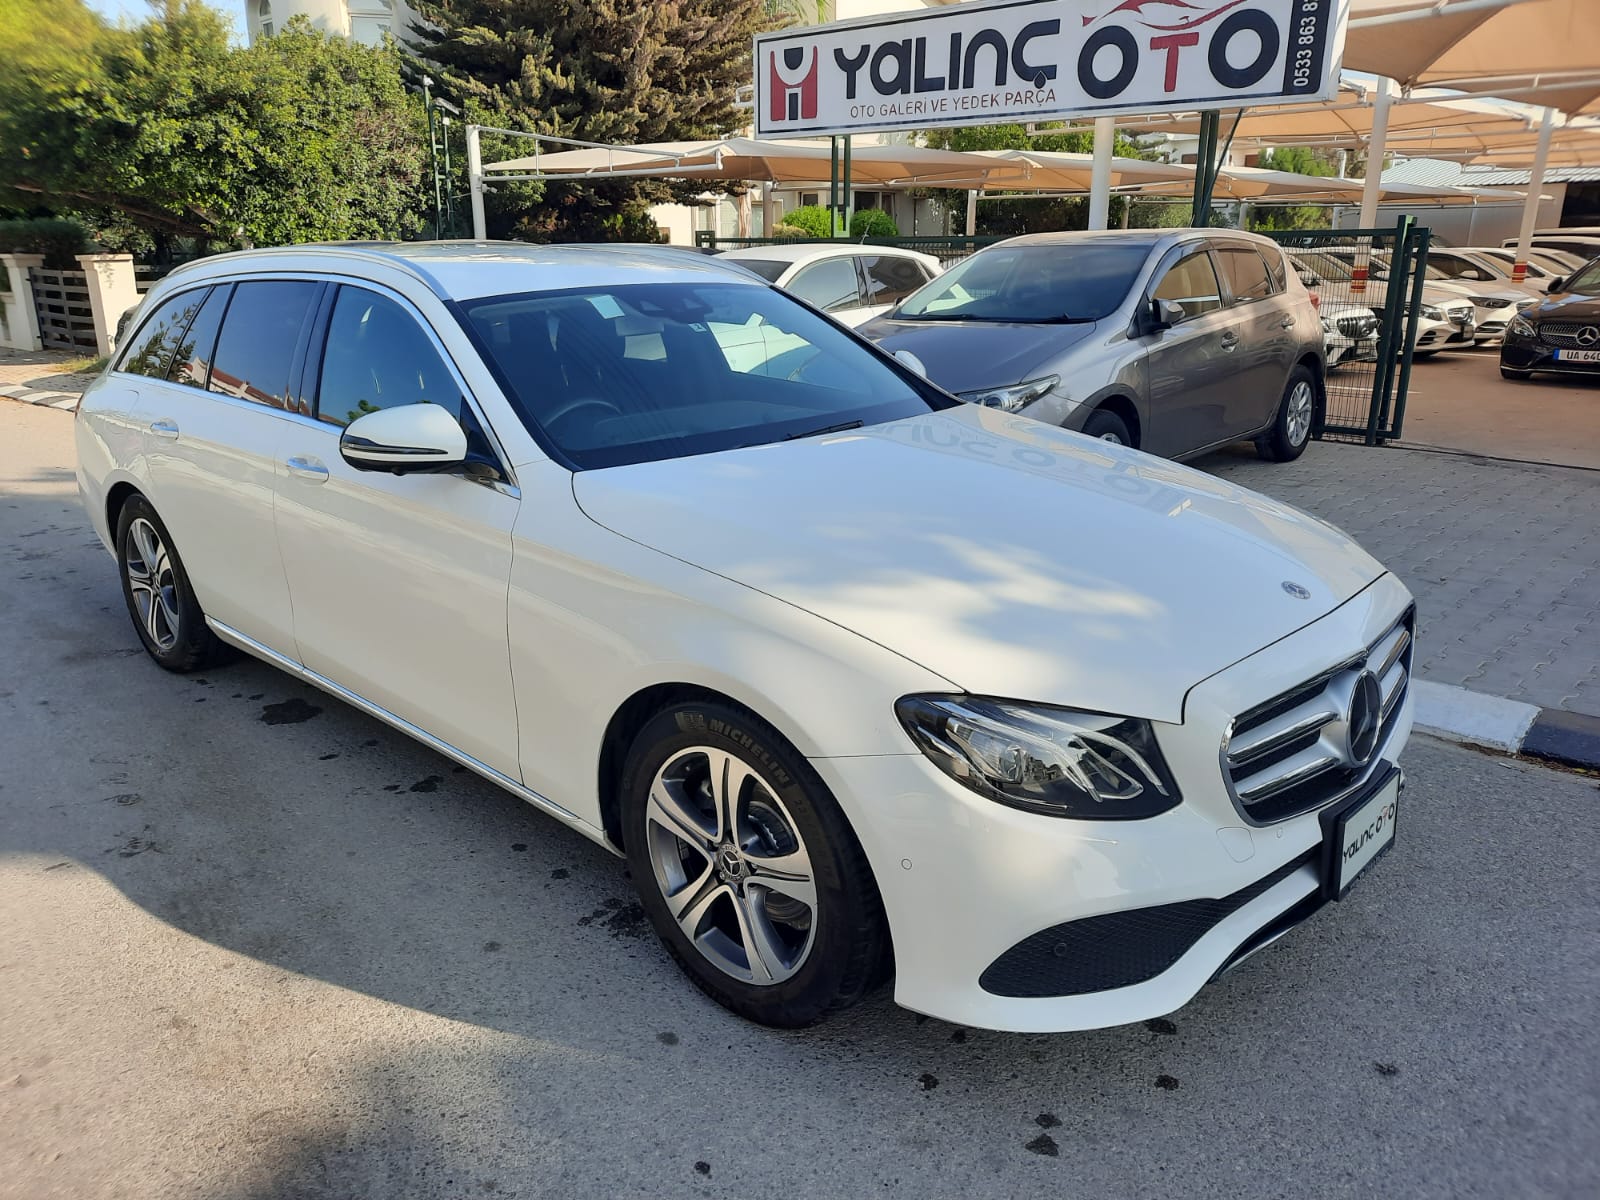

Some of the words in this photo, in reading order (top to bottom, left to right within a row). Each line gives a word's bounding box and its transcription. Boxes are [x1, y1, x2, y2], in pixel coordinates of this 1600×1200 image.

[1302, 0, 1318, 12] 8
[1298, 16, 1316, 45] 863
[1077, 8, 1280, 99] OTO
[1293, 48, 1313, 87] 0533
[850, 104, 875, 118] OTO
[879, 97, 927, 116] GALERİ
[931, 98, 948, 113] VE
[953, 93, 1000, 111] YEDEK
[1005, 88, 1056, 107] PARÇA
[1566, 351, 1580, 360] UA
[708, 718, 791, 786] MICHELIN
[1376, 803, 1394, 832] OTO
